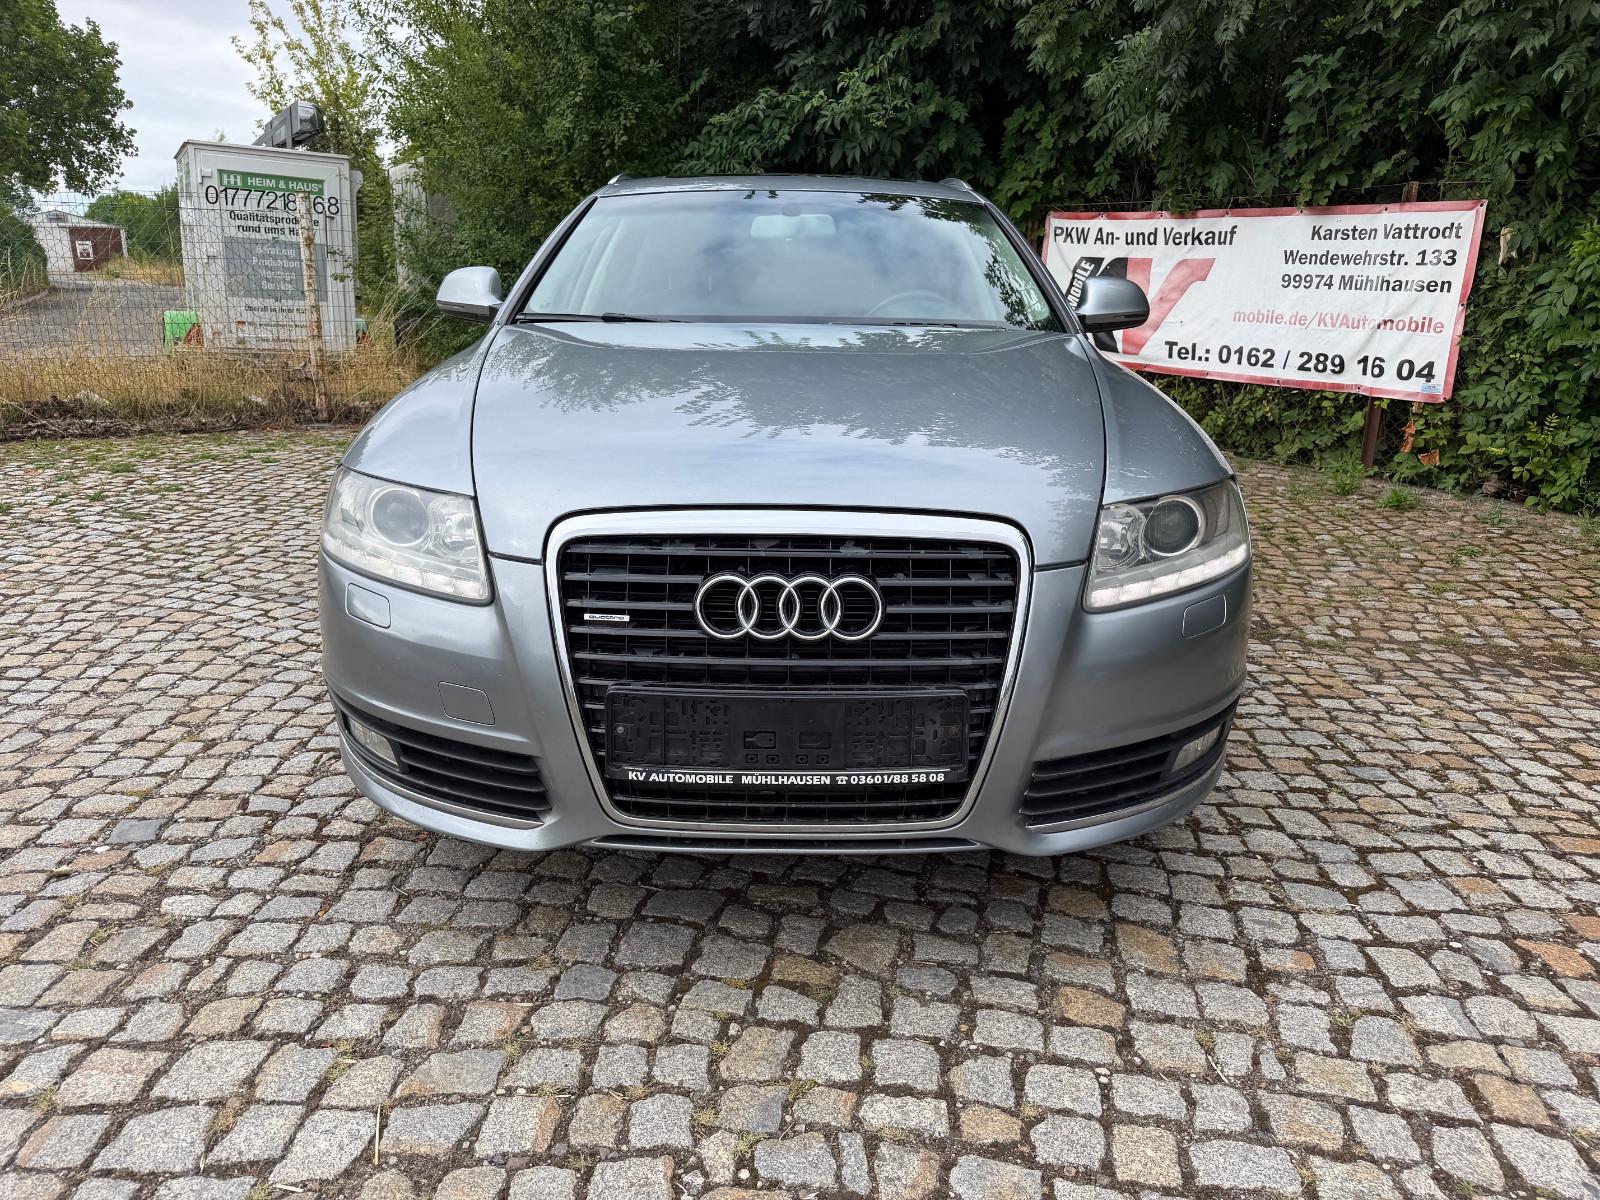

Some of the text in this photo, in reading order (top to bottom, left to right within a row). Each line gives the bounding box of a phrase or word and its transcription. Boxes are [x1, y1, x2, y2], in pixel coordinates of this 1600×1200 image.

[247, 176, 276, 188] HEIM
[278, 180, 286, 189] &
[205, 185, 340, 215] 0177721868
[237, 223, 261, 234] rund
[264, 227, 286, 236] ums
[1053, 225, 1238, 246] PKW An- und Verkauf
[1310, 222, 1463, 241] Karsten Vattrodt
[1283, 249, 1458, 267] Wendewehrstr. 133
[1280, 273, 1453, 293] 99974 Mühlhausen
[1232, 310, 1445, 334] mobile.de/KVAutomobile
[1164, 341, 1436, 383] Tel.: 0162 / 289 16 04
[628, 771, 945, 785] KV AUTOMOBILE MÜHLHAUSEN 03601/88 58 08
